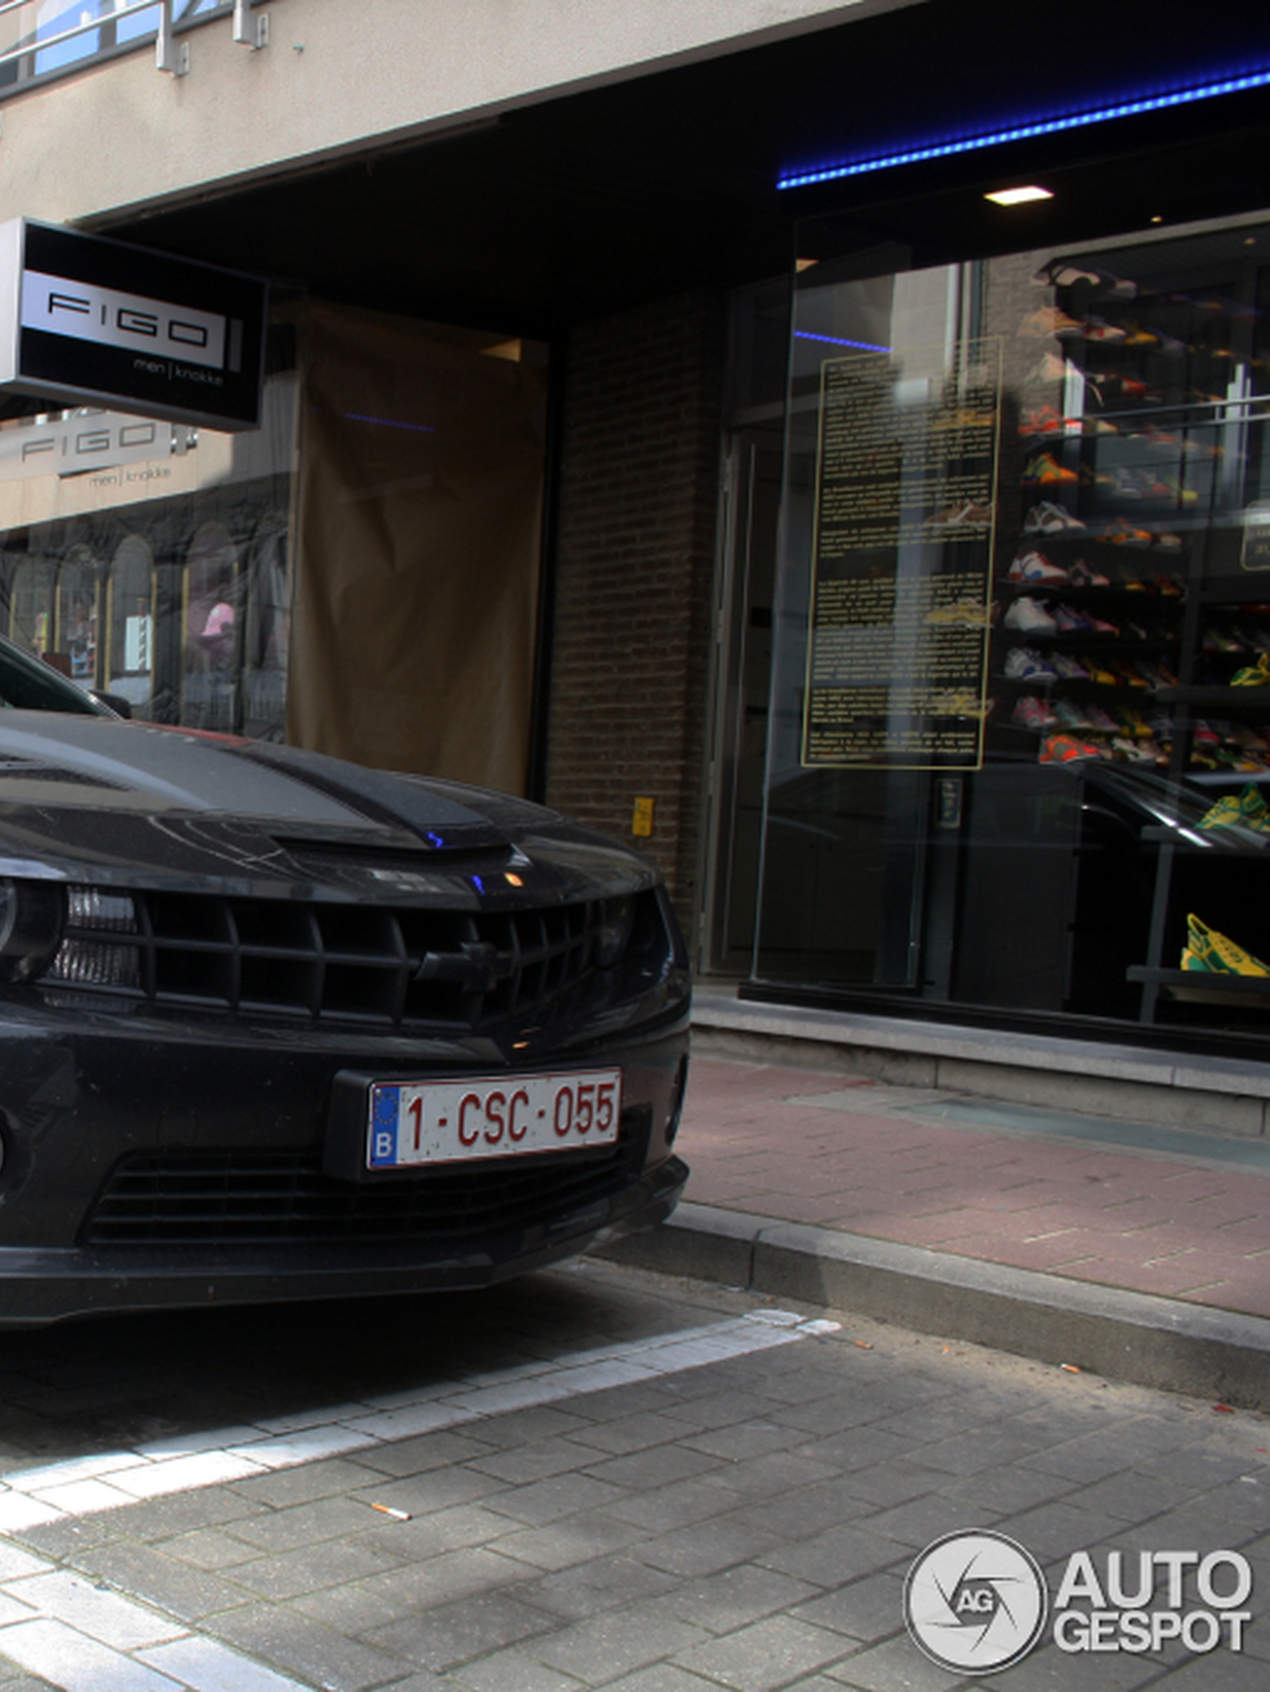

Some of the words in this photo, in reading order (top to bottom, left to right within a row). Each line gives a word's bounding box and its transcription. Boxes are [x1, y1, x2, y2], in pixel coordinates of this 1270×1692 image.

[48, 292, 208, 348] FIGO
[133, 358, 165, 376] men
[175, 366, 224, 386] knokke
[22, 422, 156, 462] FIGO
[89, 473, 118, 488] men
[126, 466, 172, 485] knokke
[376, 1132, 392, 1158] B
